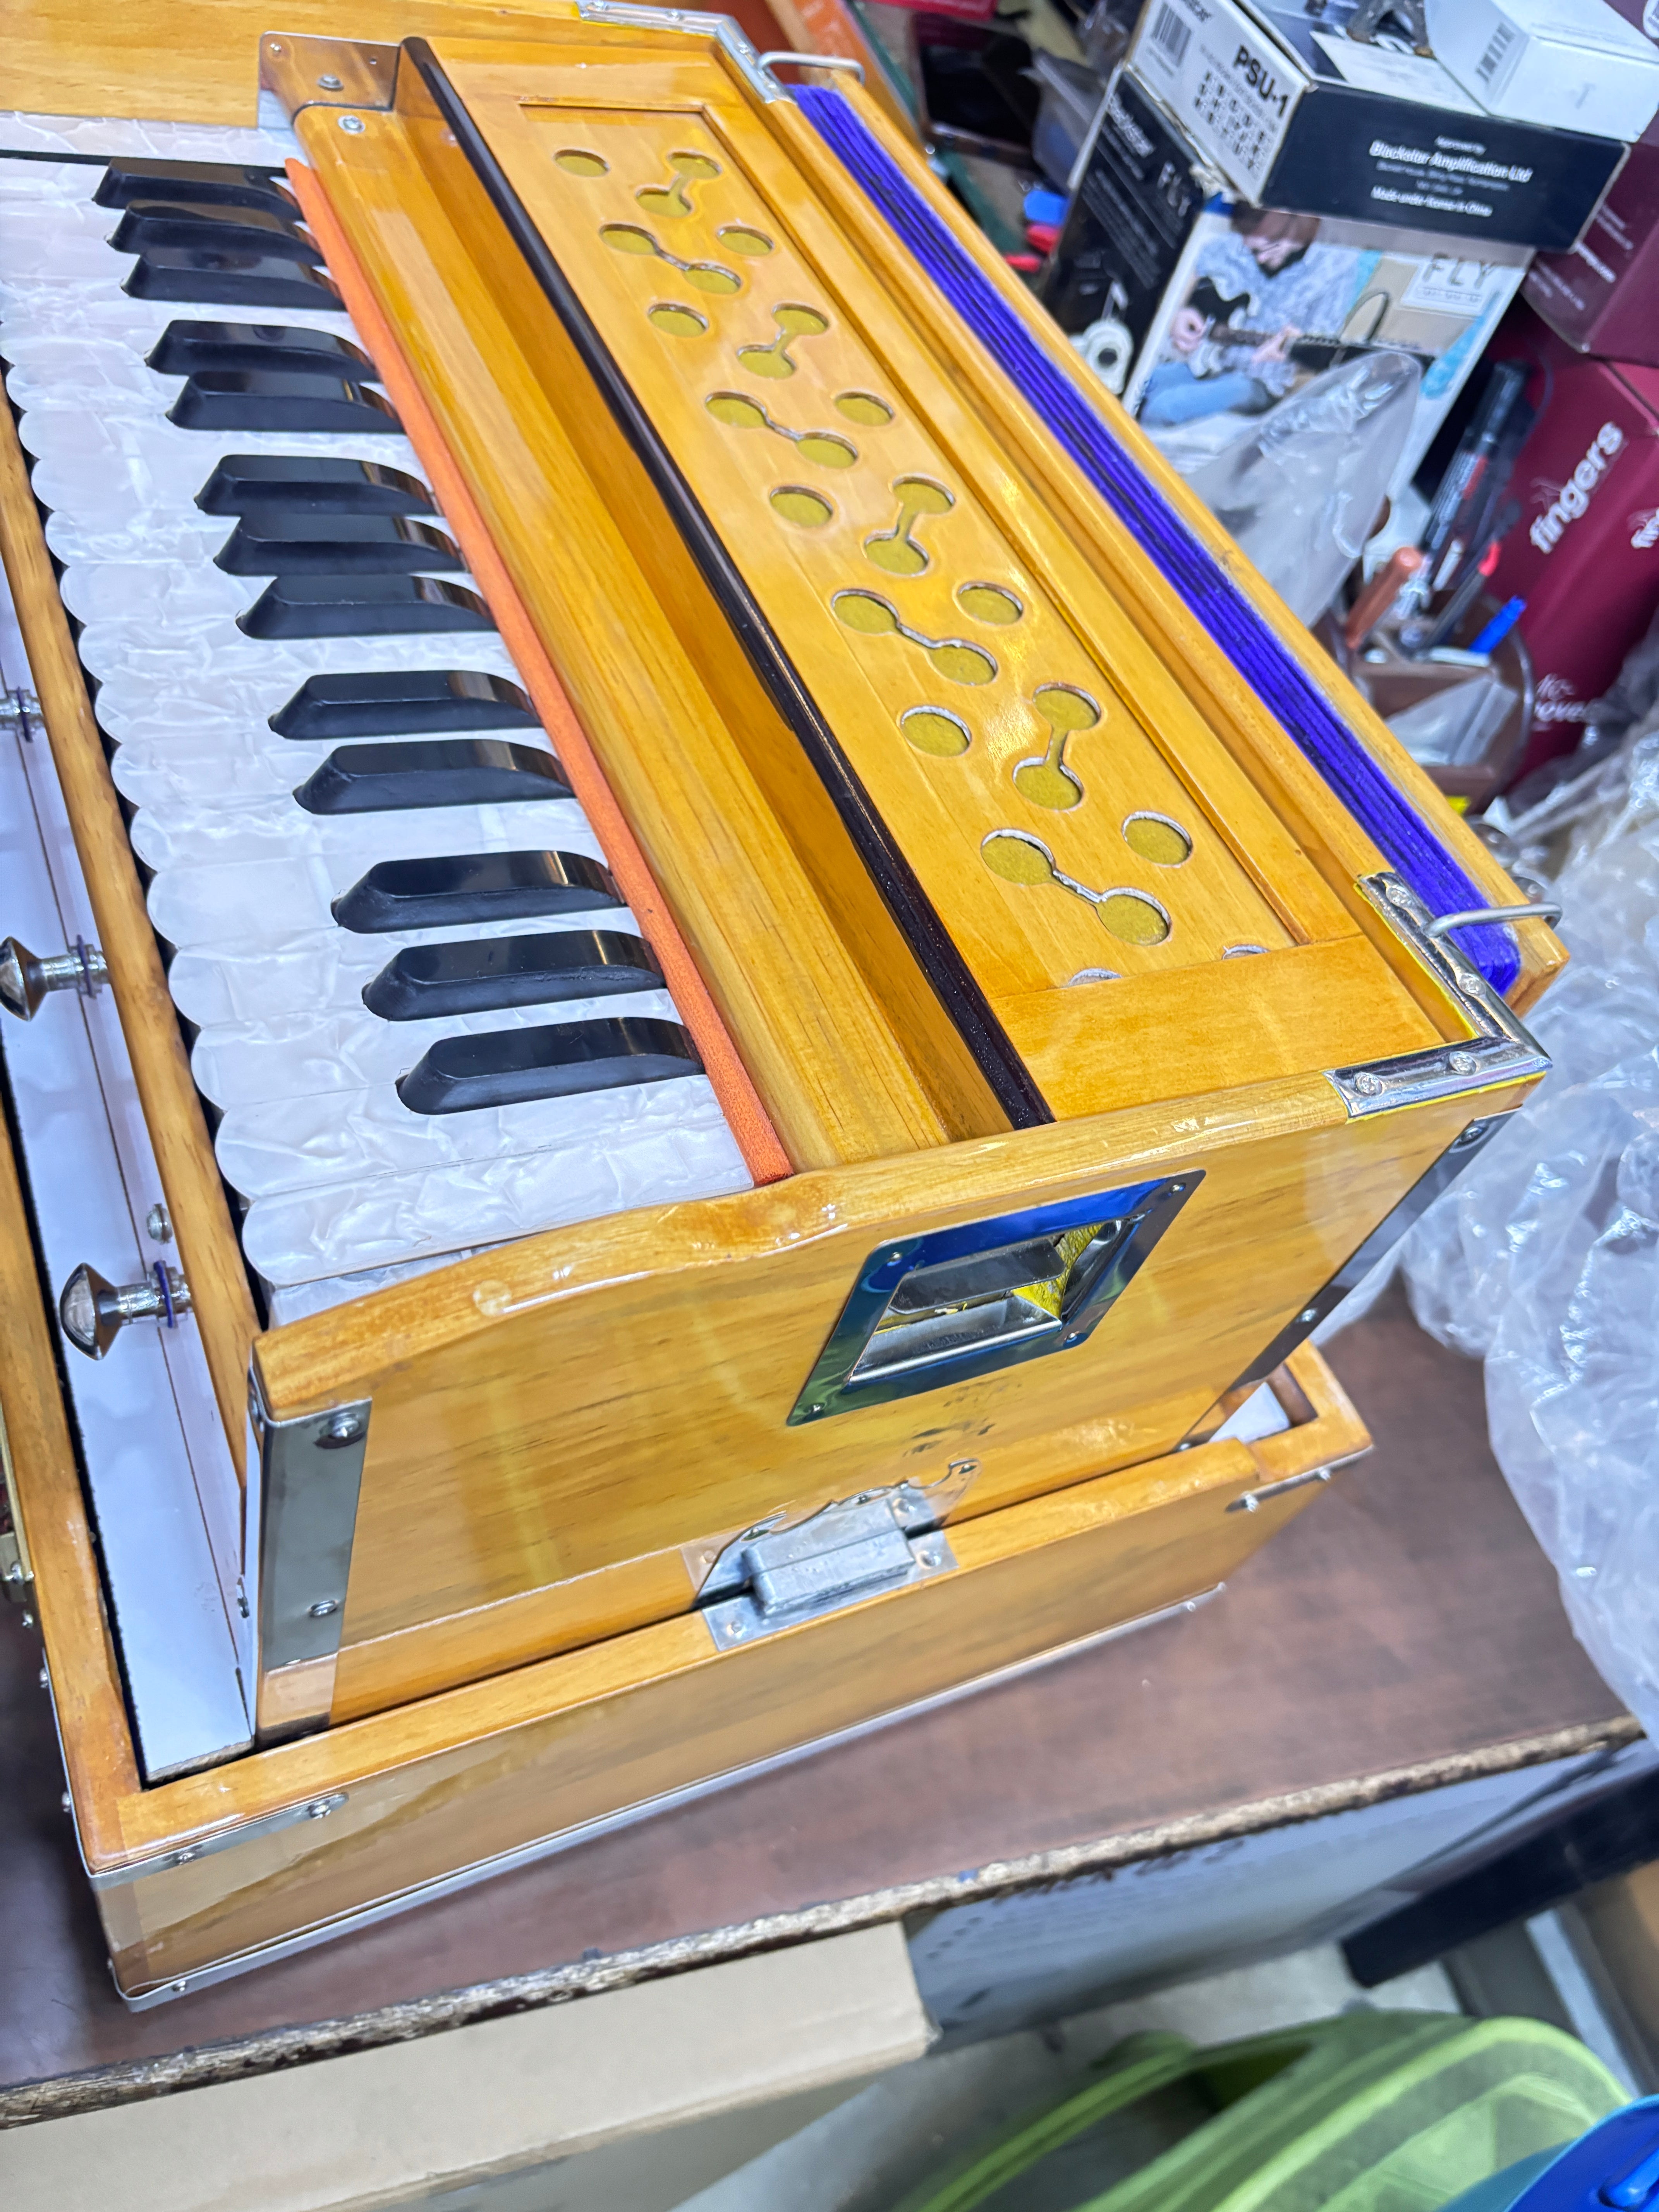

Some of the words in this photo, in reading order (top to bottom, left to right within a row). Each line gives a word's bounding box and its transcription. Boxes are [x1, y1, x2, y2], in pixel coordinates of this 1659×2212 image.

[1233, 45, 1288, 117] PSU-1
[1369, 139, 1432, 164] Blackstar
[1428, 150, 1509, 179] Amplification
[1422, 252, 1497, 289] FLY
[1530, 421, 1623, 554] fingers
